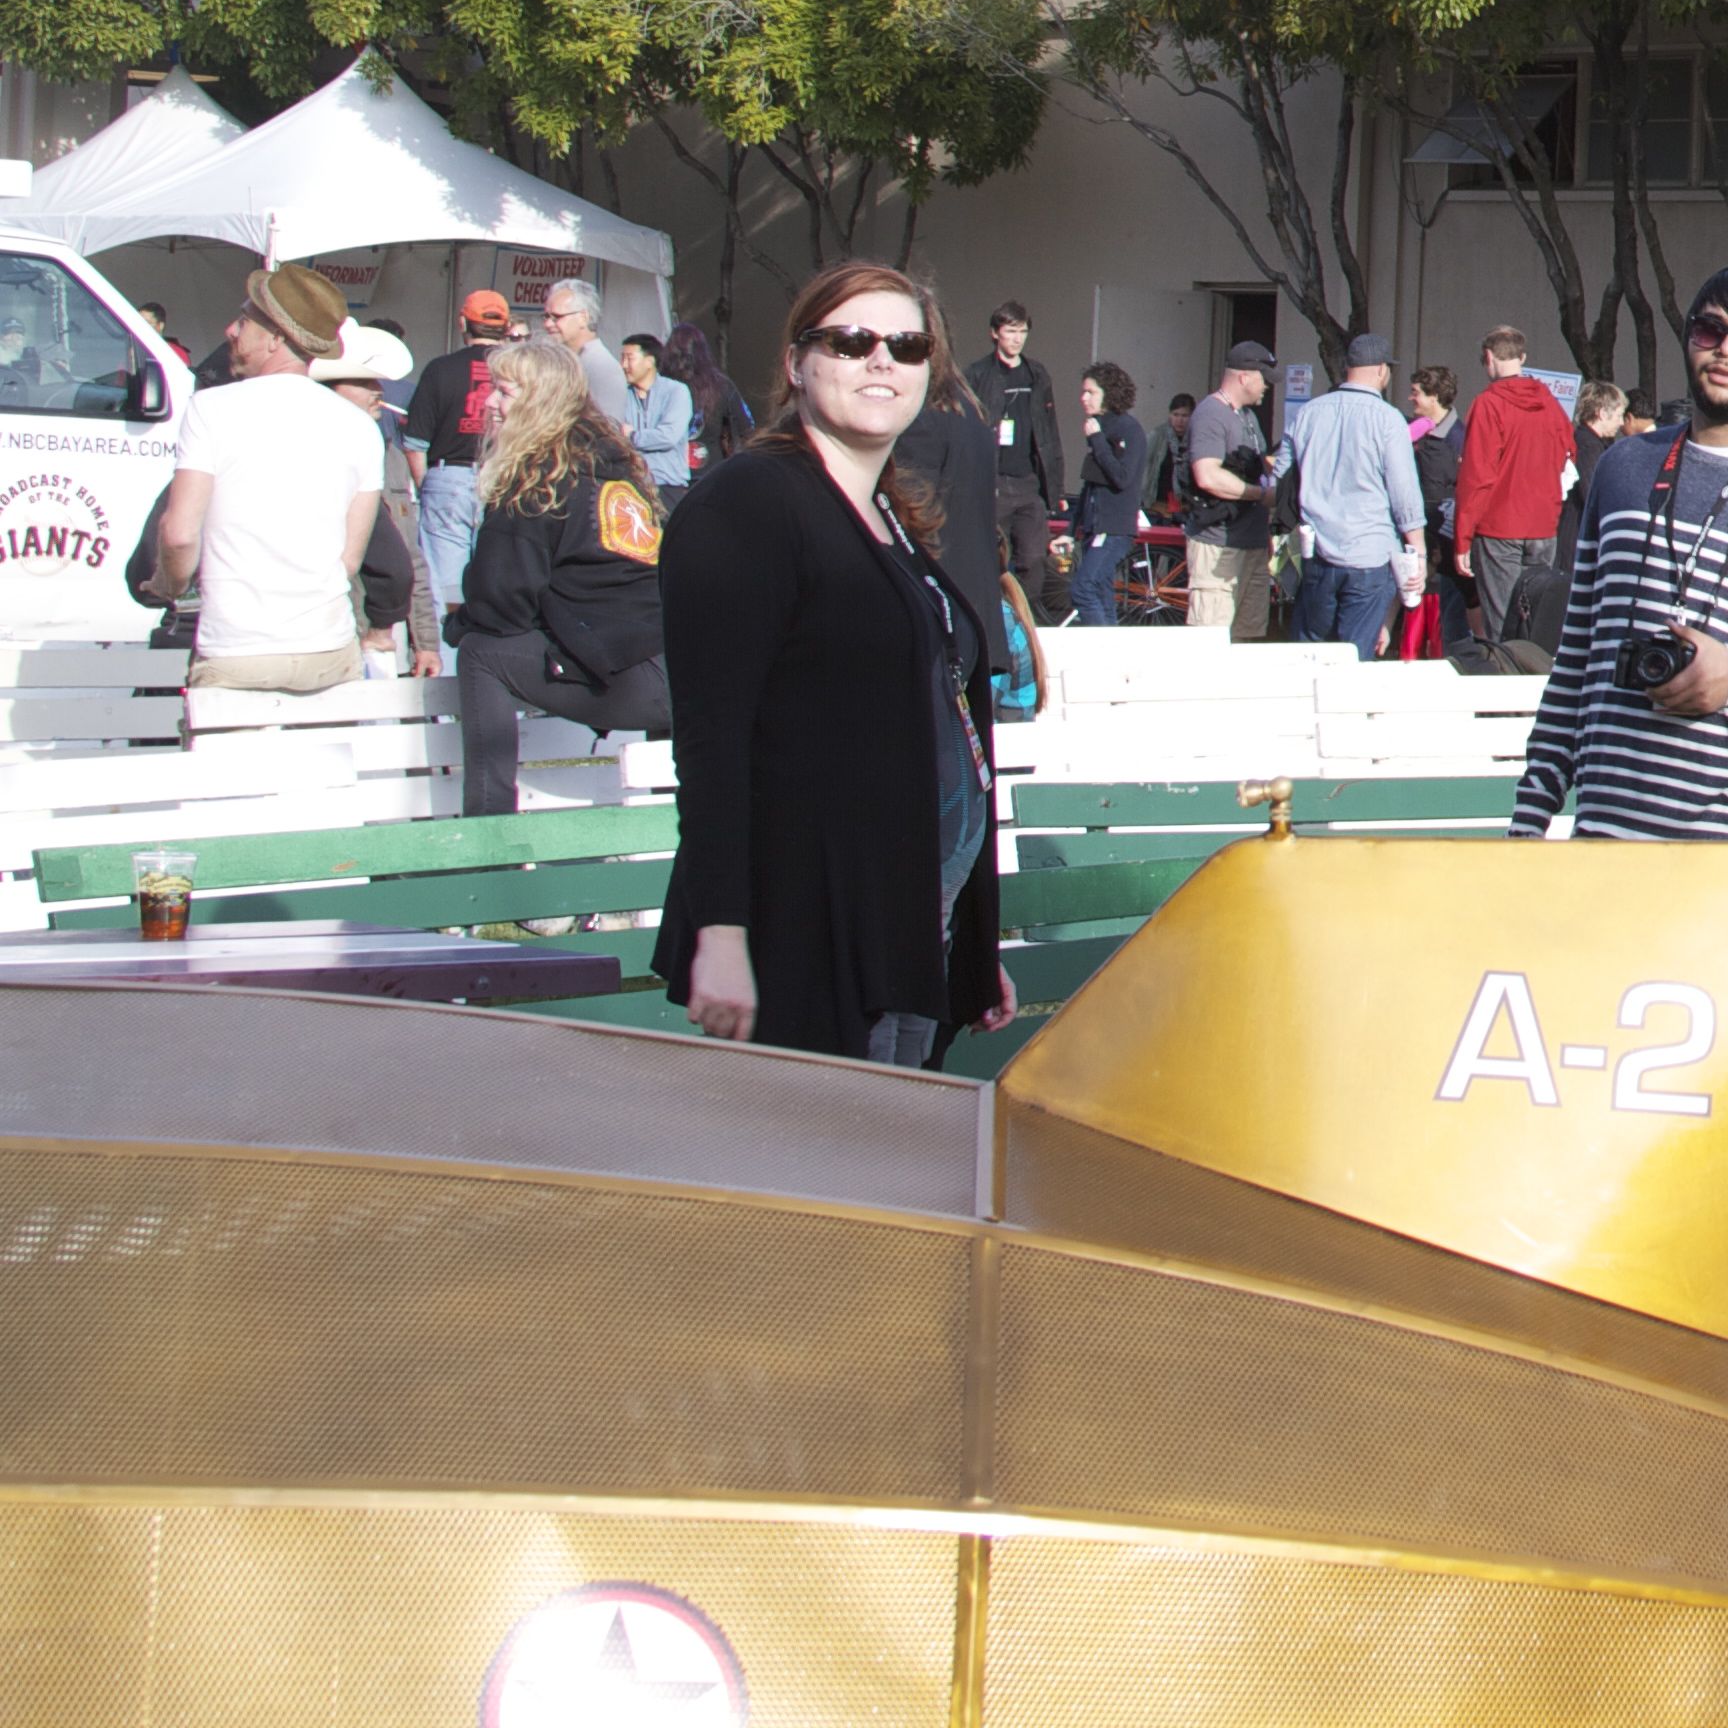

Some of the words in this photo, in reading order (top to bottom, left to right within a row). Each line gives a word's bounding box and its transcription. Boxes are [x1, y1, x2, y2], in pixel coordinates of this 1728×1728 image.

[512, 255, 585, 278] VOLUNTEER
[514, 281, 550, 304] CHEC
[0, 431, 178, 459] .NBCBAYAREA.COM
[28, 492, 43, 505] OF
[48, 491, 71, 507] THE
[76, 485, 109, 531] HOME
